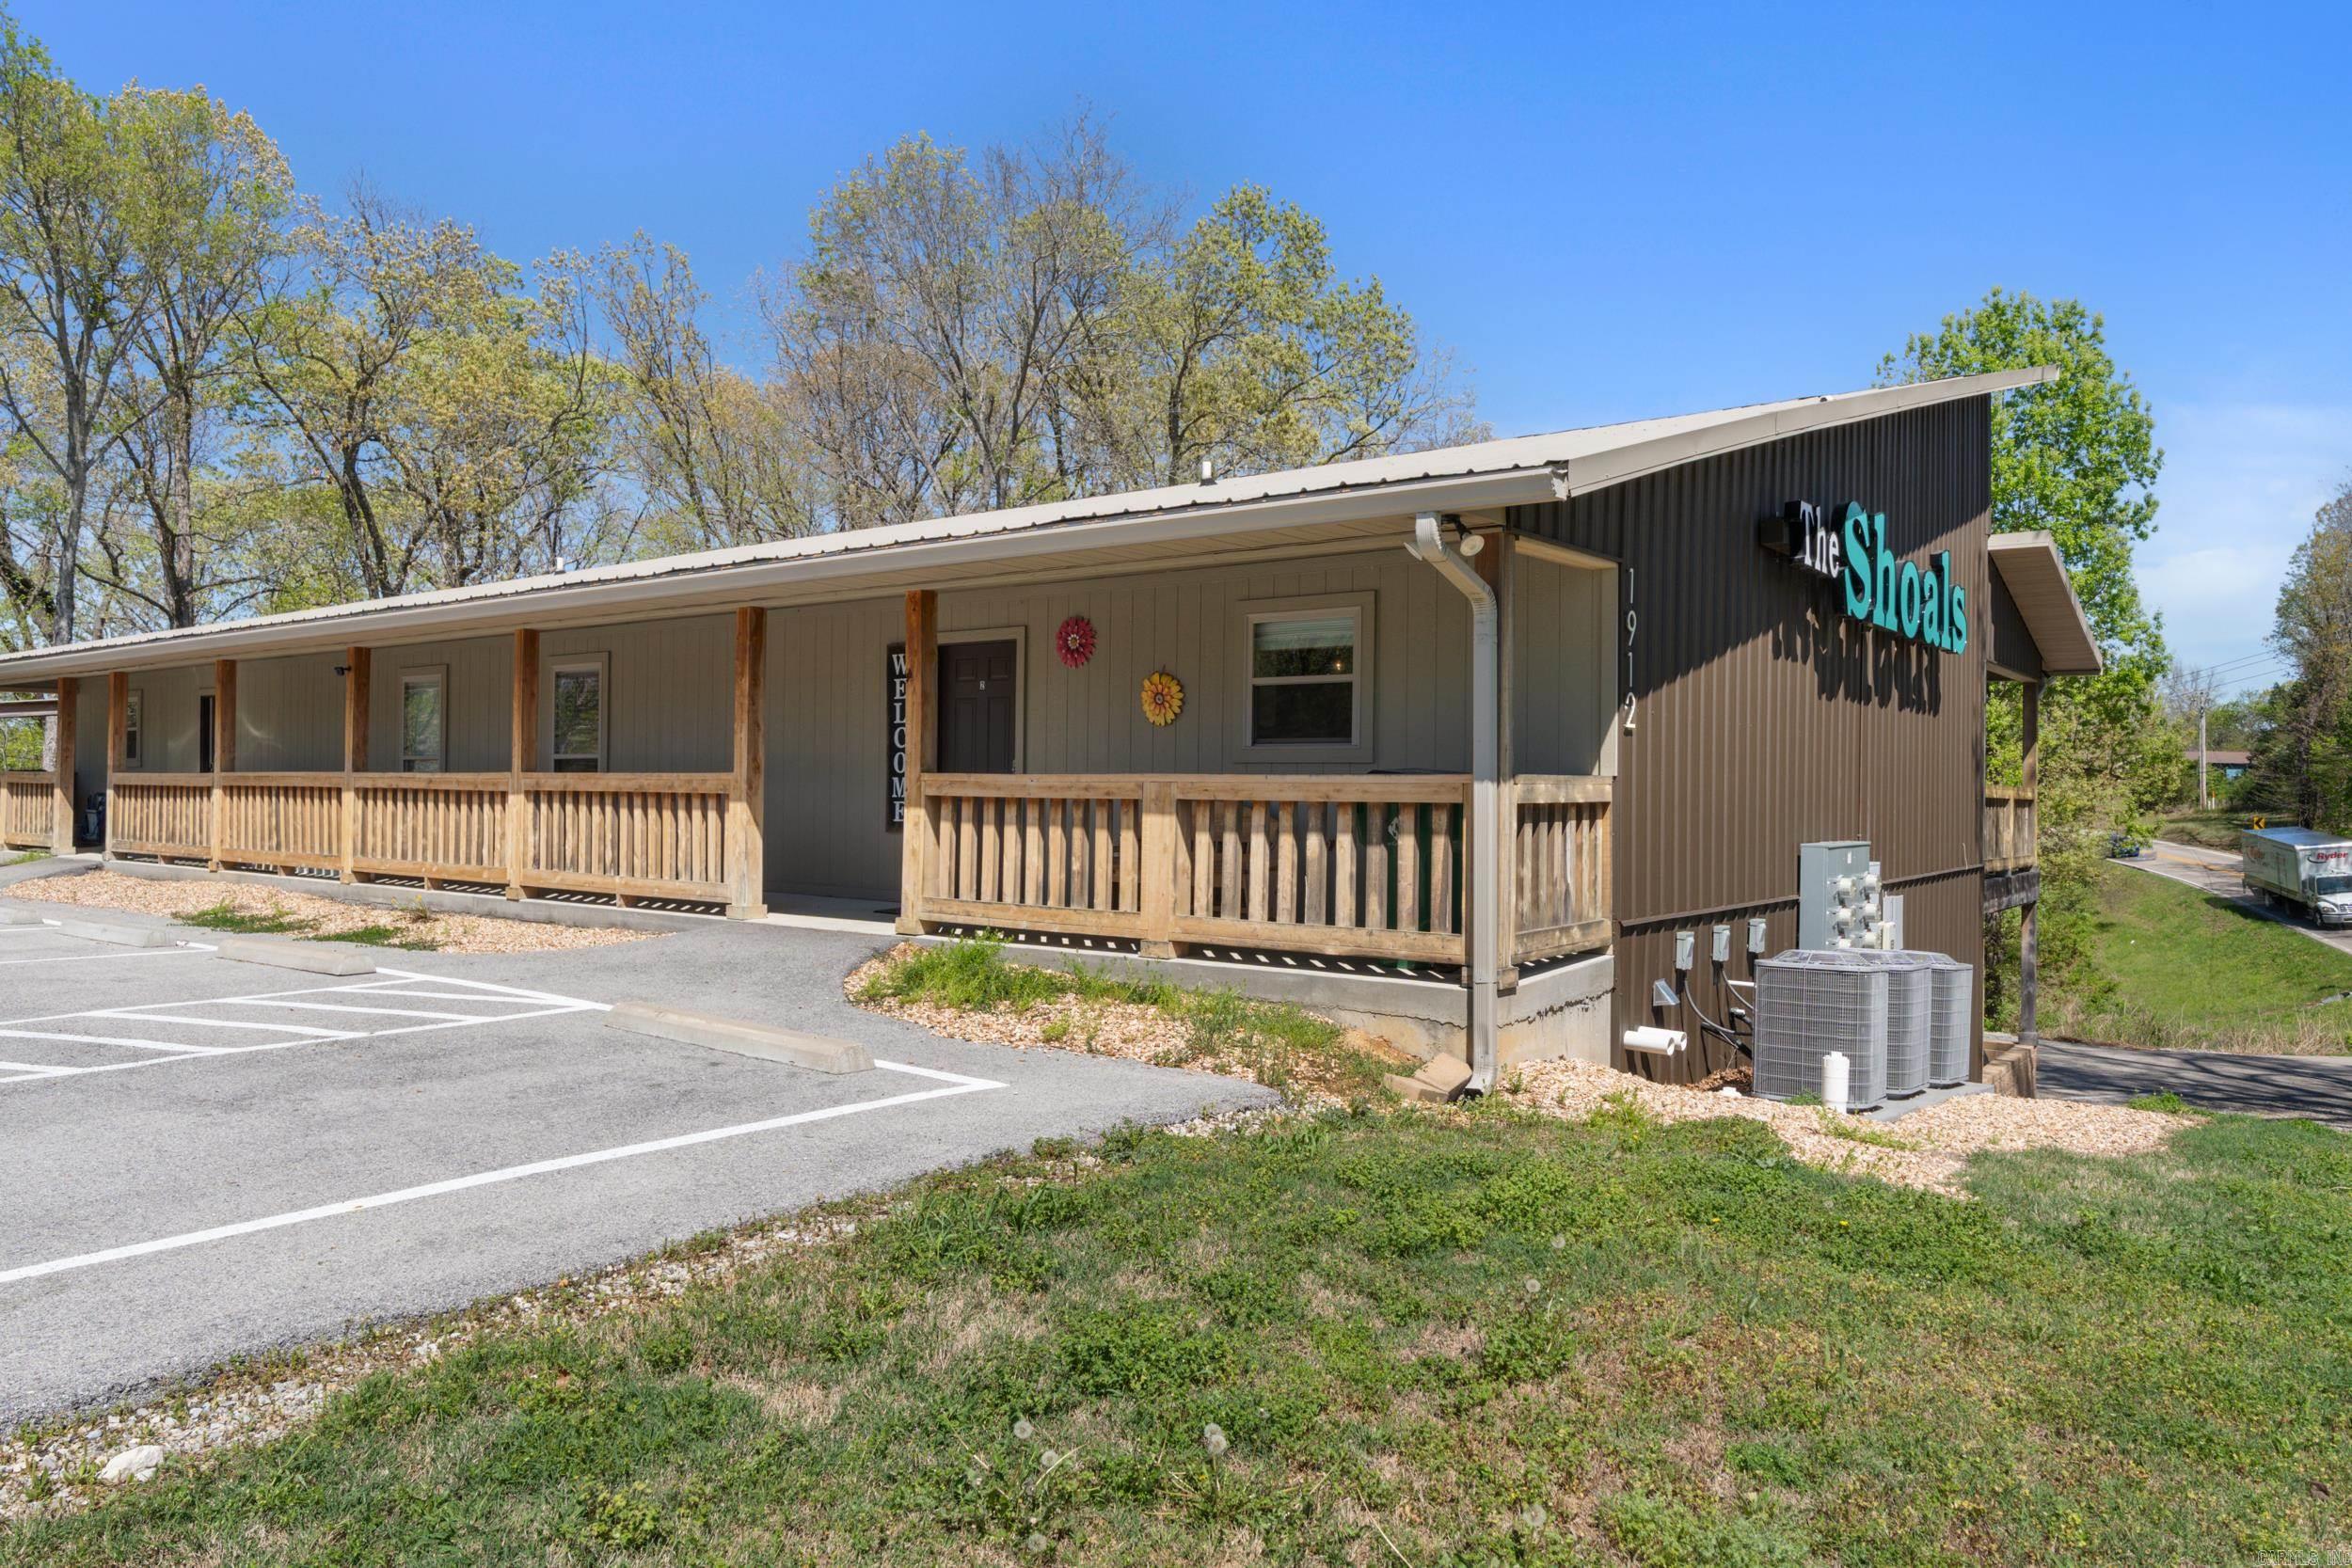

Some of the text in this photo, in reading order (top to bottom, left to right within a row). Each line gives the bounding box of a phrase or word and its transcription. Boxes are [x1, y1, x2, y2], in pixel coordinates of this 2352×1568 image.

[1625, 567, 1637, 729] 1912
[1800, 500, 1968, 655] The Shoals
[2316, 851, 2349, 861] Ryder
